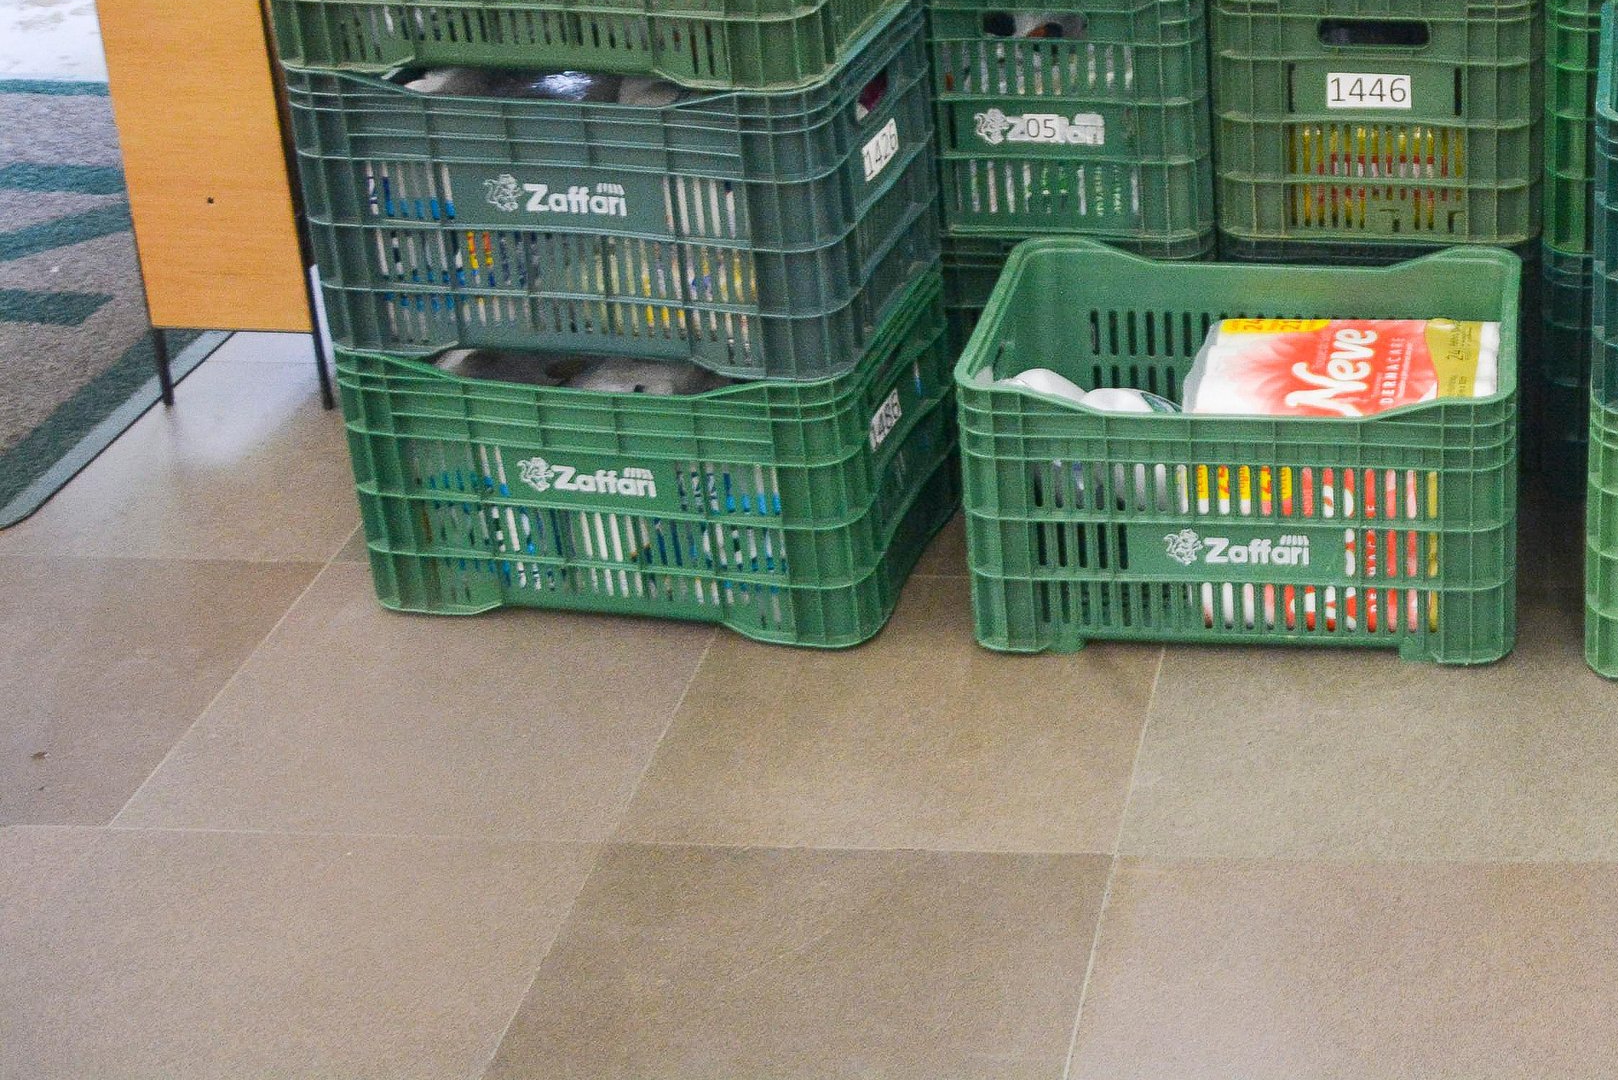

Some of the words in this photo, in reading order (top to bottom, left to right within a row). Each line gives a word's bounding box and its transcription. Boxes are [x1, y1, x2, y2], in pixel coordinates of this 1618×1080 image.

[1330, 77, 1407, 102] 1446
[1026, 118, 1056, 139] 05
[865, 123, 897, 177] 1426
[522, 183, 628, 217] Zaffari
[1285, 328, 1379, 417] Neve
[550, 467, 657, 498] Zaffari
[1203, 535, 1310, 566] Zaffari
